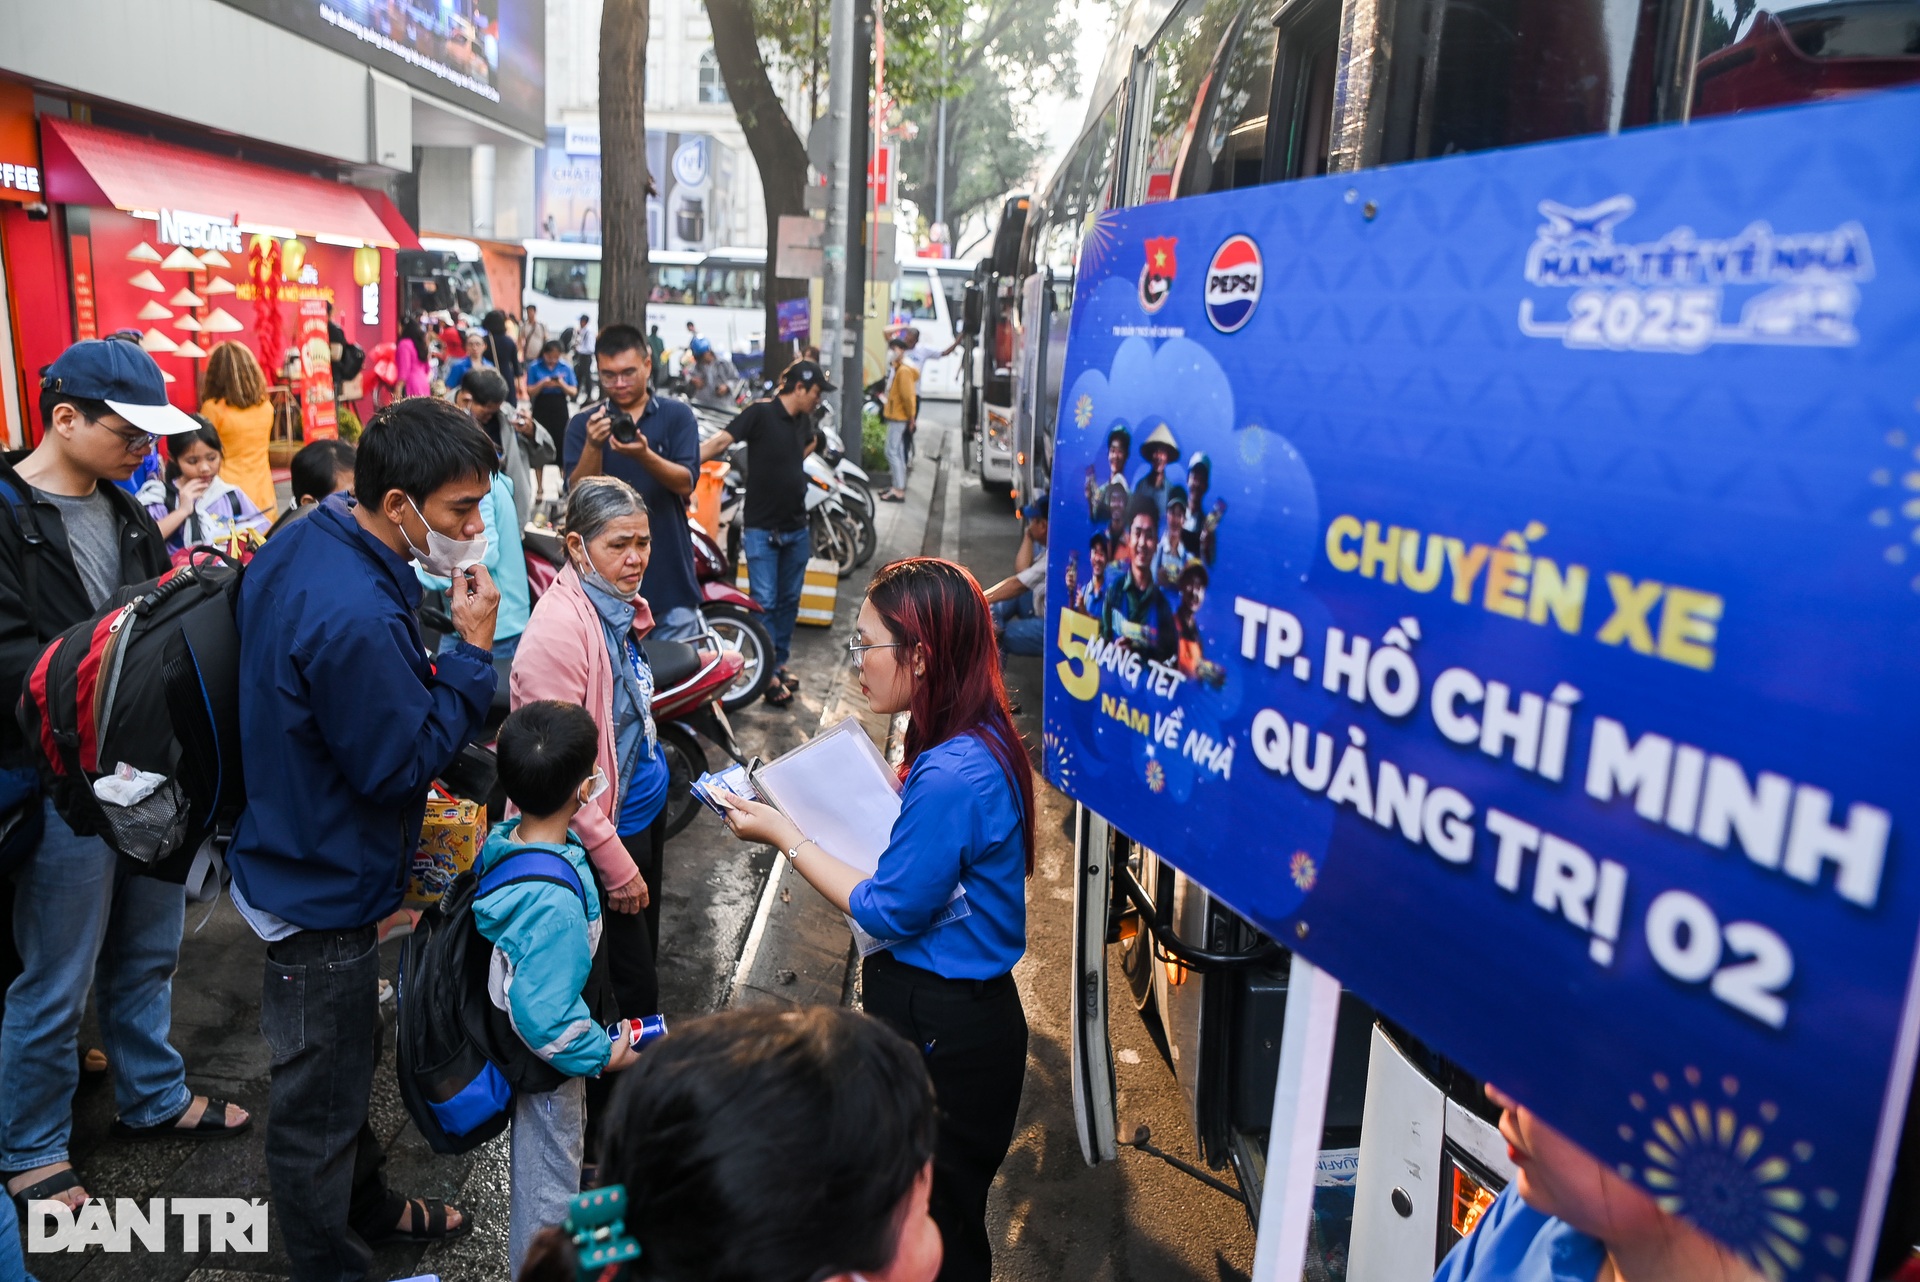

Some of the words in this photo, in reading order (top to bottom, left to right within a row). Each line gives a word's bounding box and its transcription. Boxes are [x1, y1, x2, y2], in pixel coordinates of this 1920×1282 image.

[0, 162, 40, 192] FEE
[1210, 274, 1257, 293] PEPSI
[1569, 290, 1719, 351] 2025
[1326, 515, 1590, 635] CHUYẾN
[1599, 573, 1725, 671] XE
[1056, 607, 1100, 701] 5
[1084, 633, 1142, 689] MANG
[1147, 654, 1187, 700] TẾT
[1101, 692, 1150, 736] NĂM
[1154, 705, 1185, 749] VỀ
[1183, 728, 1237, 782] NHÀ
[1233, 596, 1312, 682] TP.
[1322, 616, 1422, 719] HỒ
[1431, 667, 1583, 781] CHÍ
[1585, 716, 1893, 908] MINH
[1251, 709, 1474, 865] QUẢNG
[1485, 808, 1629, 967] TRỊ
[1645, 889, 1796, 1029] 02
